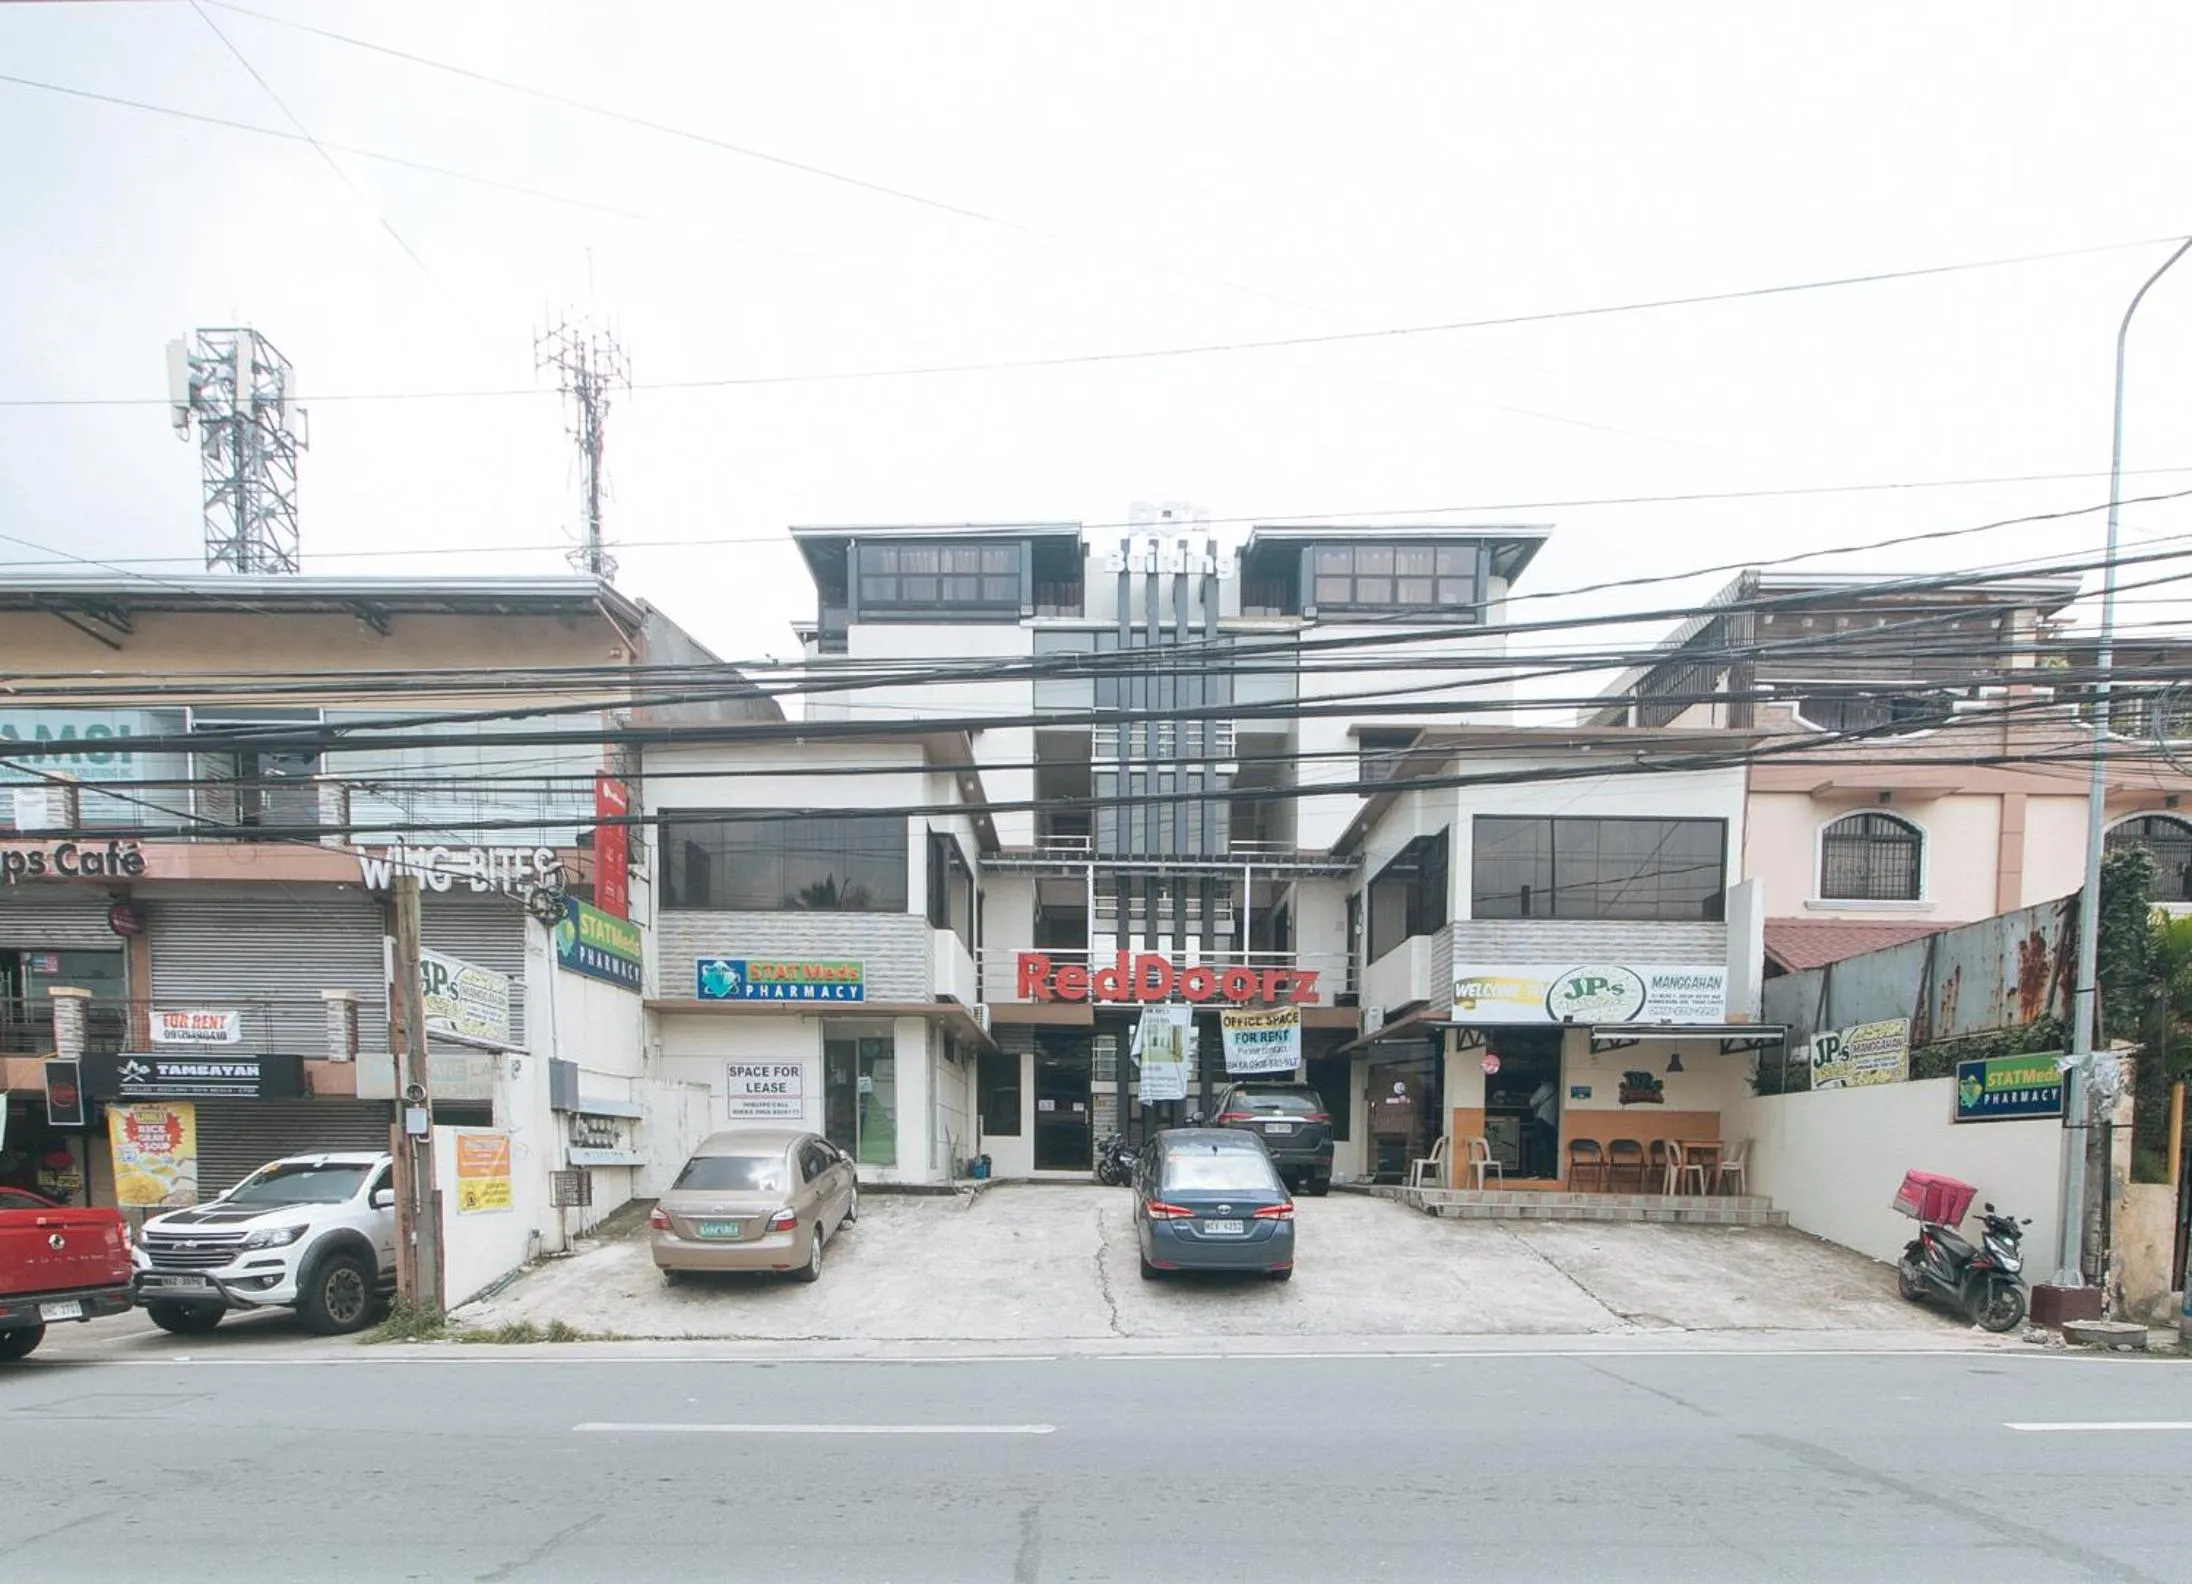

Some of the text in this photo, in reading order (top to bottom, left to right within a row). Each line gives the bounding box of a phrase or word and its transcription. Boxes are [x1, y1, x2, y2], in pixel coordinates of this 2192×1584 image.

[357, 846, 452, 892] WING
[579, 945, 641, 982] PHARMACY
[750, 962, 860, 981] STAT Meds
[1016, 948, 1320, 1003] RedDoorz
[1651, 975, 1722, 990] MANGGAHAN
[746, 984, 858, 999] PHARMACY
[163, 1013, 228, 1029] FOR RENT
[1223, 1011, 1299, 1028] OFFICE SPACE
[1235, 1029, 1289, 1044] FOR RENT
[157, 1065, 260, 1076] TAMBAYAN
[729, 1066, 799, 1077] SPACE FOR
[746, 1082, 787, 1093] LEASE
[1984, 1088, 2059, 1104] PHARMACY
